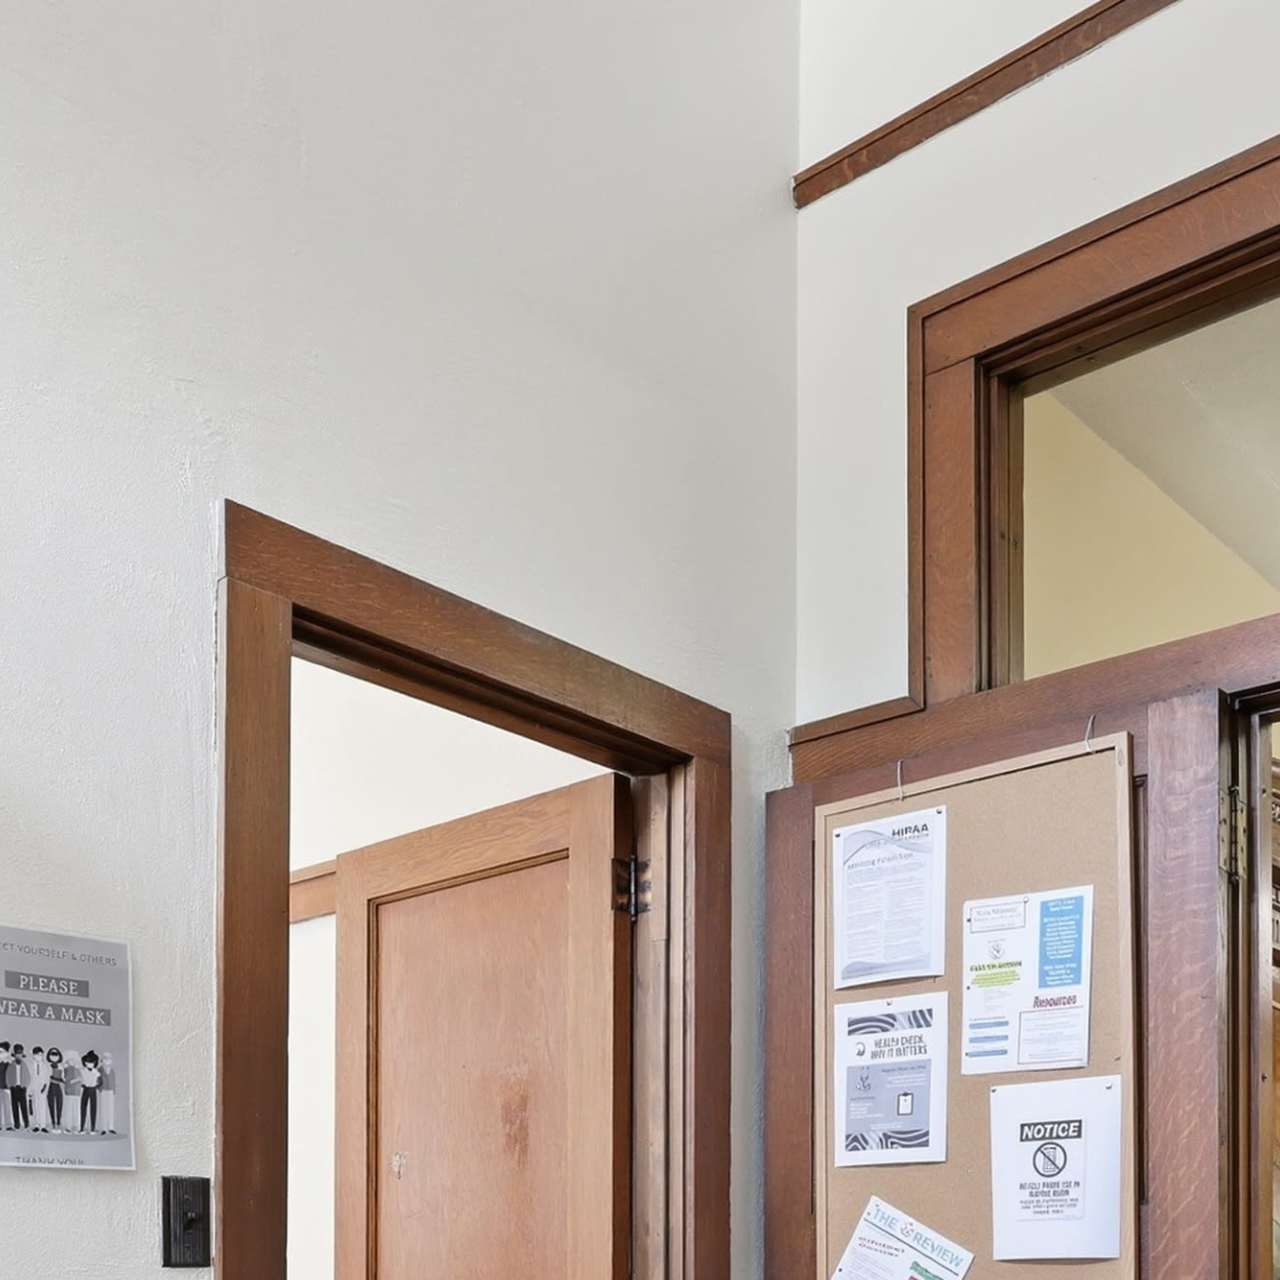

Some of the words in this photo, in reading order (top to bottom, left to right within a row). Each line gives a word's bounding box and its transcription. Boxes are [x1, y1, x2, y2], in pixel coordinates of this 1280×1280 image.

[17, 944, 67, 960] YOURSELF
[80, 954, 118, 966] OTHERS
[20, 975, 79, 995] PLEASE
[44, 1006, 56, 1019] A
[61, 1007, 106, 1025] MASK
[1022, 1122, 1080, 1140] NOTICE
[873, 1209, 898, 1229] THE
[912, 1232, 964, 1267] REVIEW
